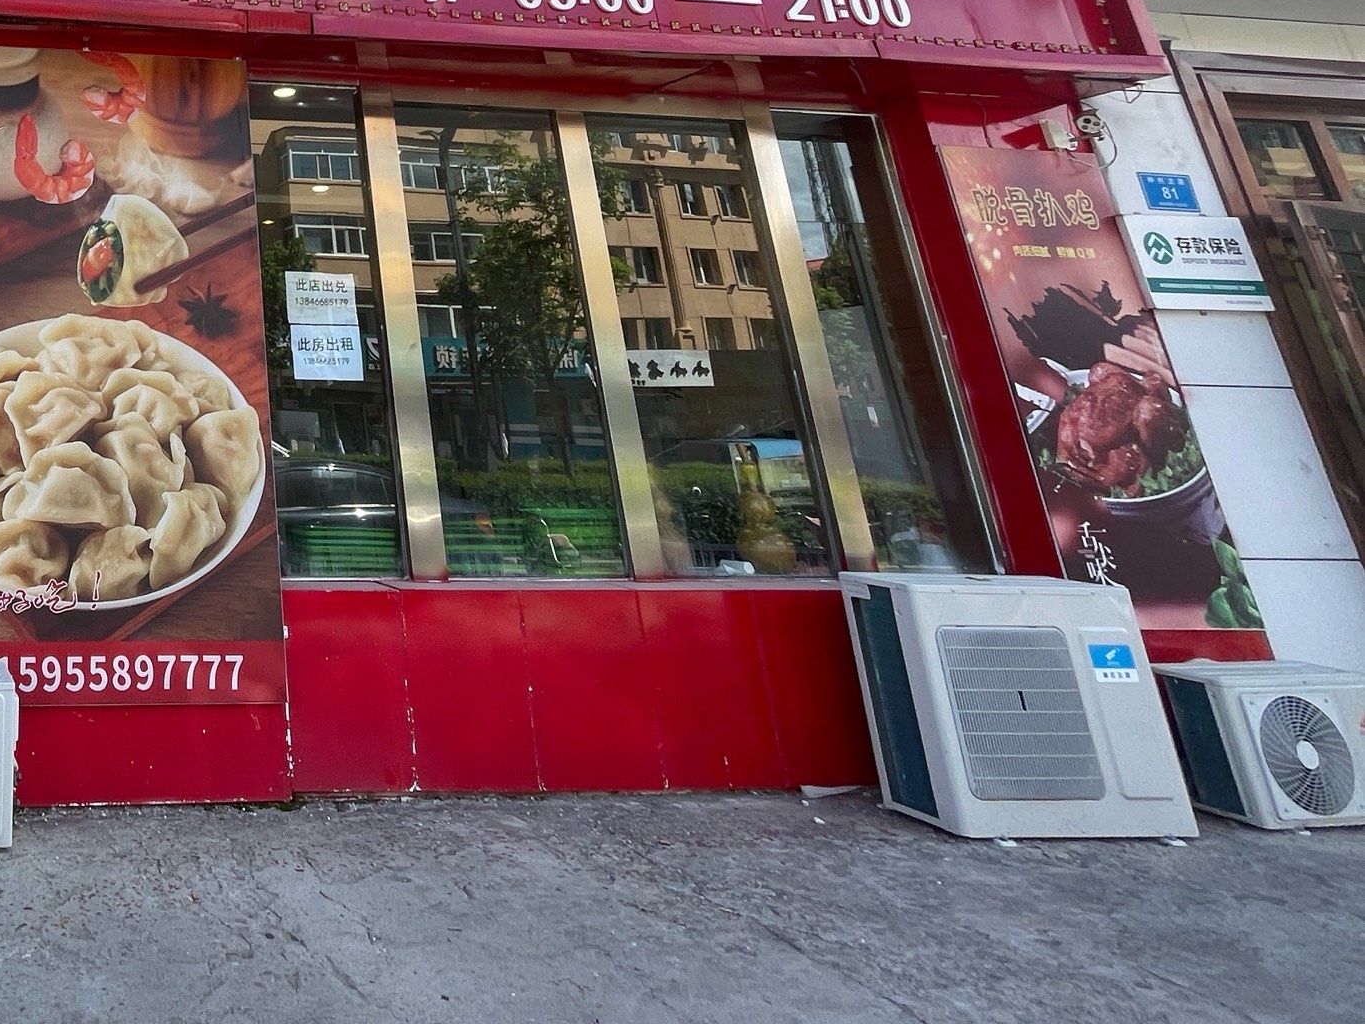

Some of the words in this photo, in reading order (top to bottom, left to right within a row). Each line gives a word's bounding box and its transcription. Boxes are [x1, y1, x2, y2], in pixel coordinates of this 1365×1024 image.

[1161, 186, 1179, 200] 81
[971, 185, 1100, 230] 脱骨扒鸡
[1174, 237, 1243, 255] 存款保险
[295, 279, 348, 293] 此店出兑
[297, 337, 355, 352] 此房出租
[1077, 521, 1127, 588] 舌尖味
